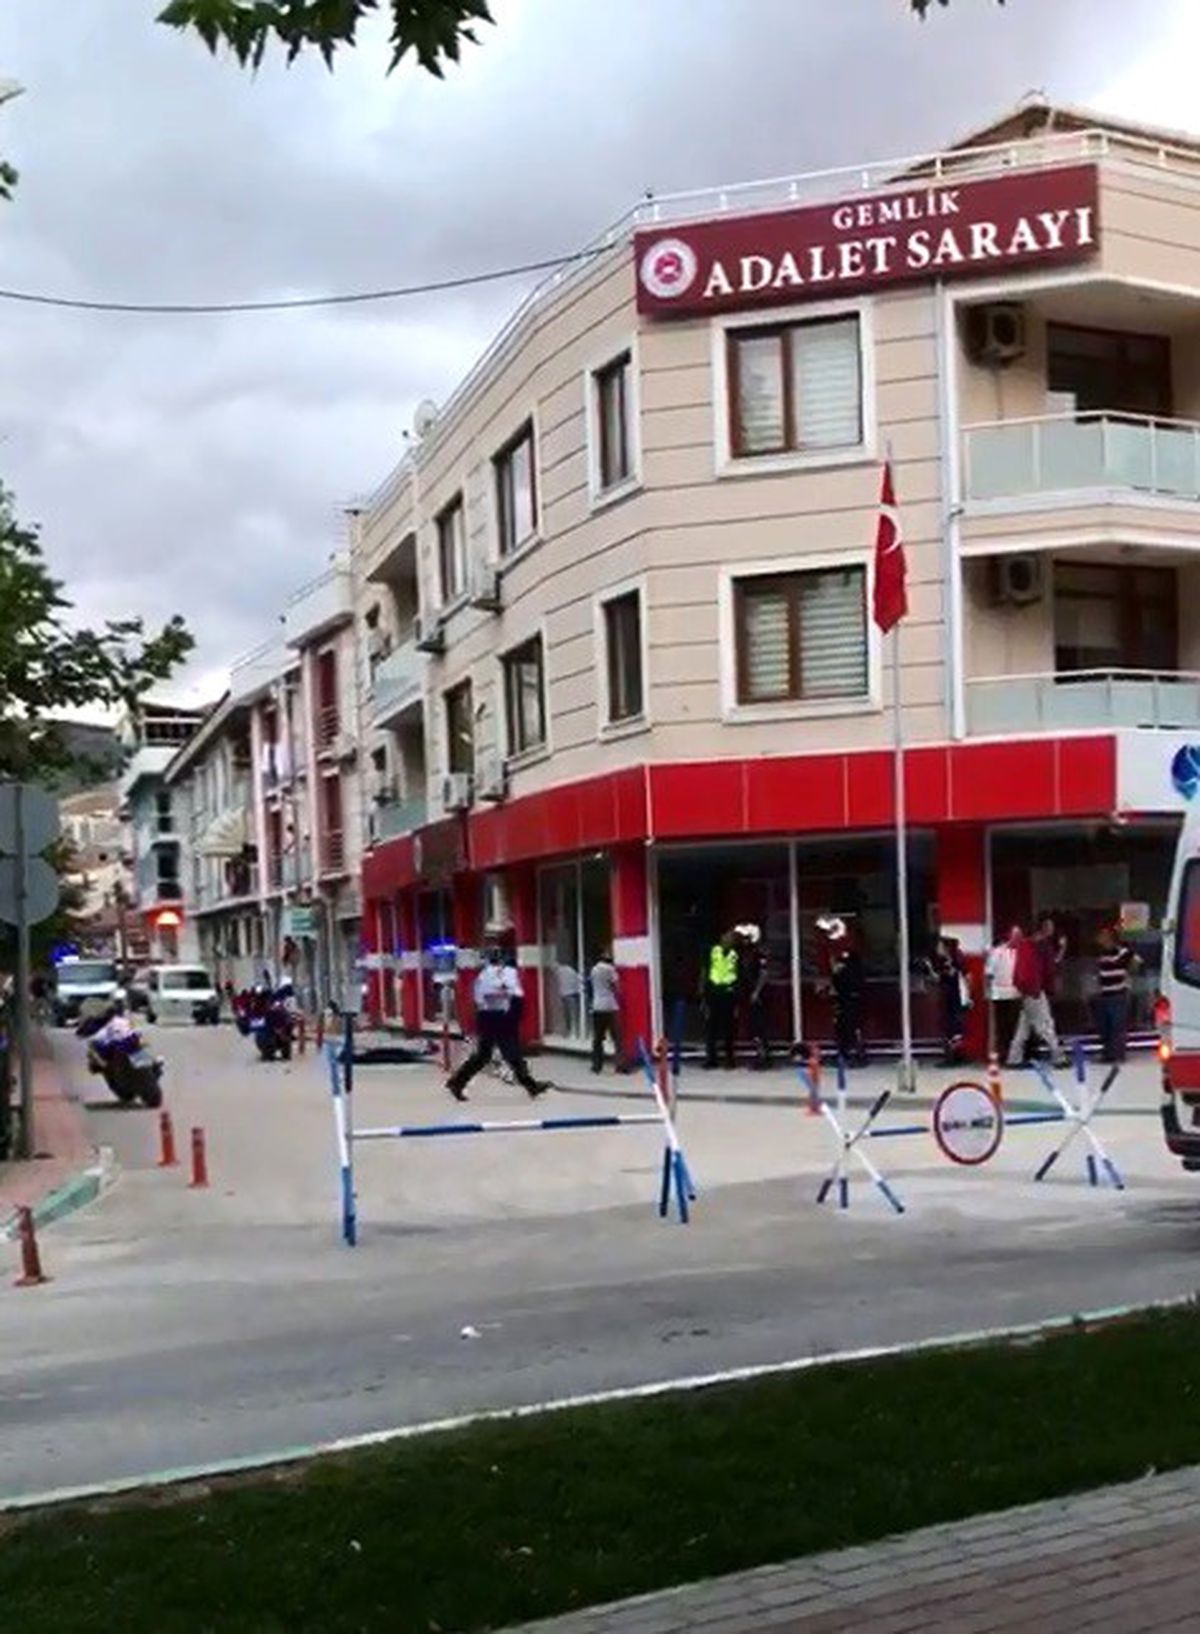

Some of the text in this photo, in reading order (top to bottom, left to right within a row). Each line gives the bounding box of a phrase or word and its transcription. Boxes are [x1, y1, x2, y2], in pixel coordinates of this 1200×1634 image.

[833, 190, 960, 230] GEMLİK
[703, 206, 1093, 298] ADALET SARAYI
